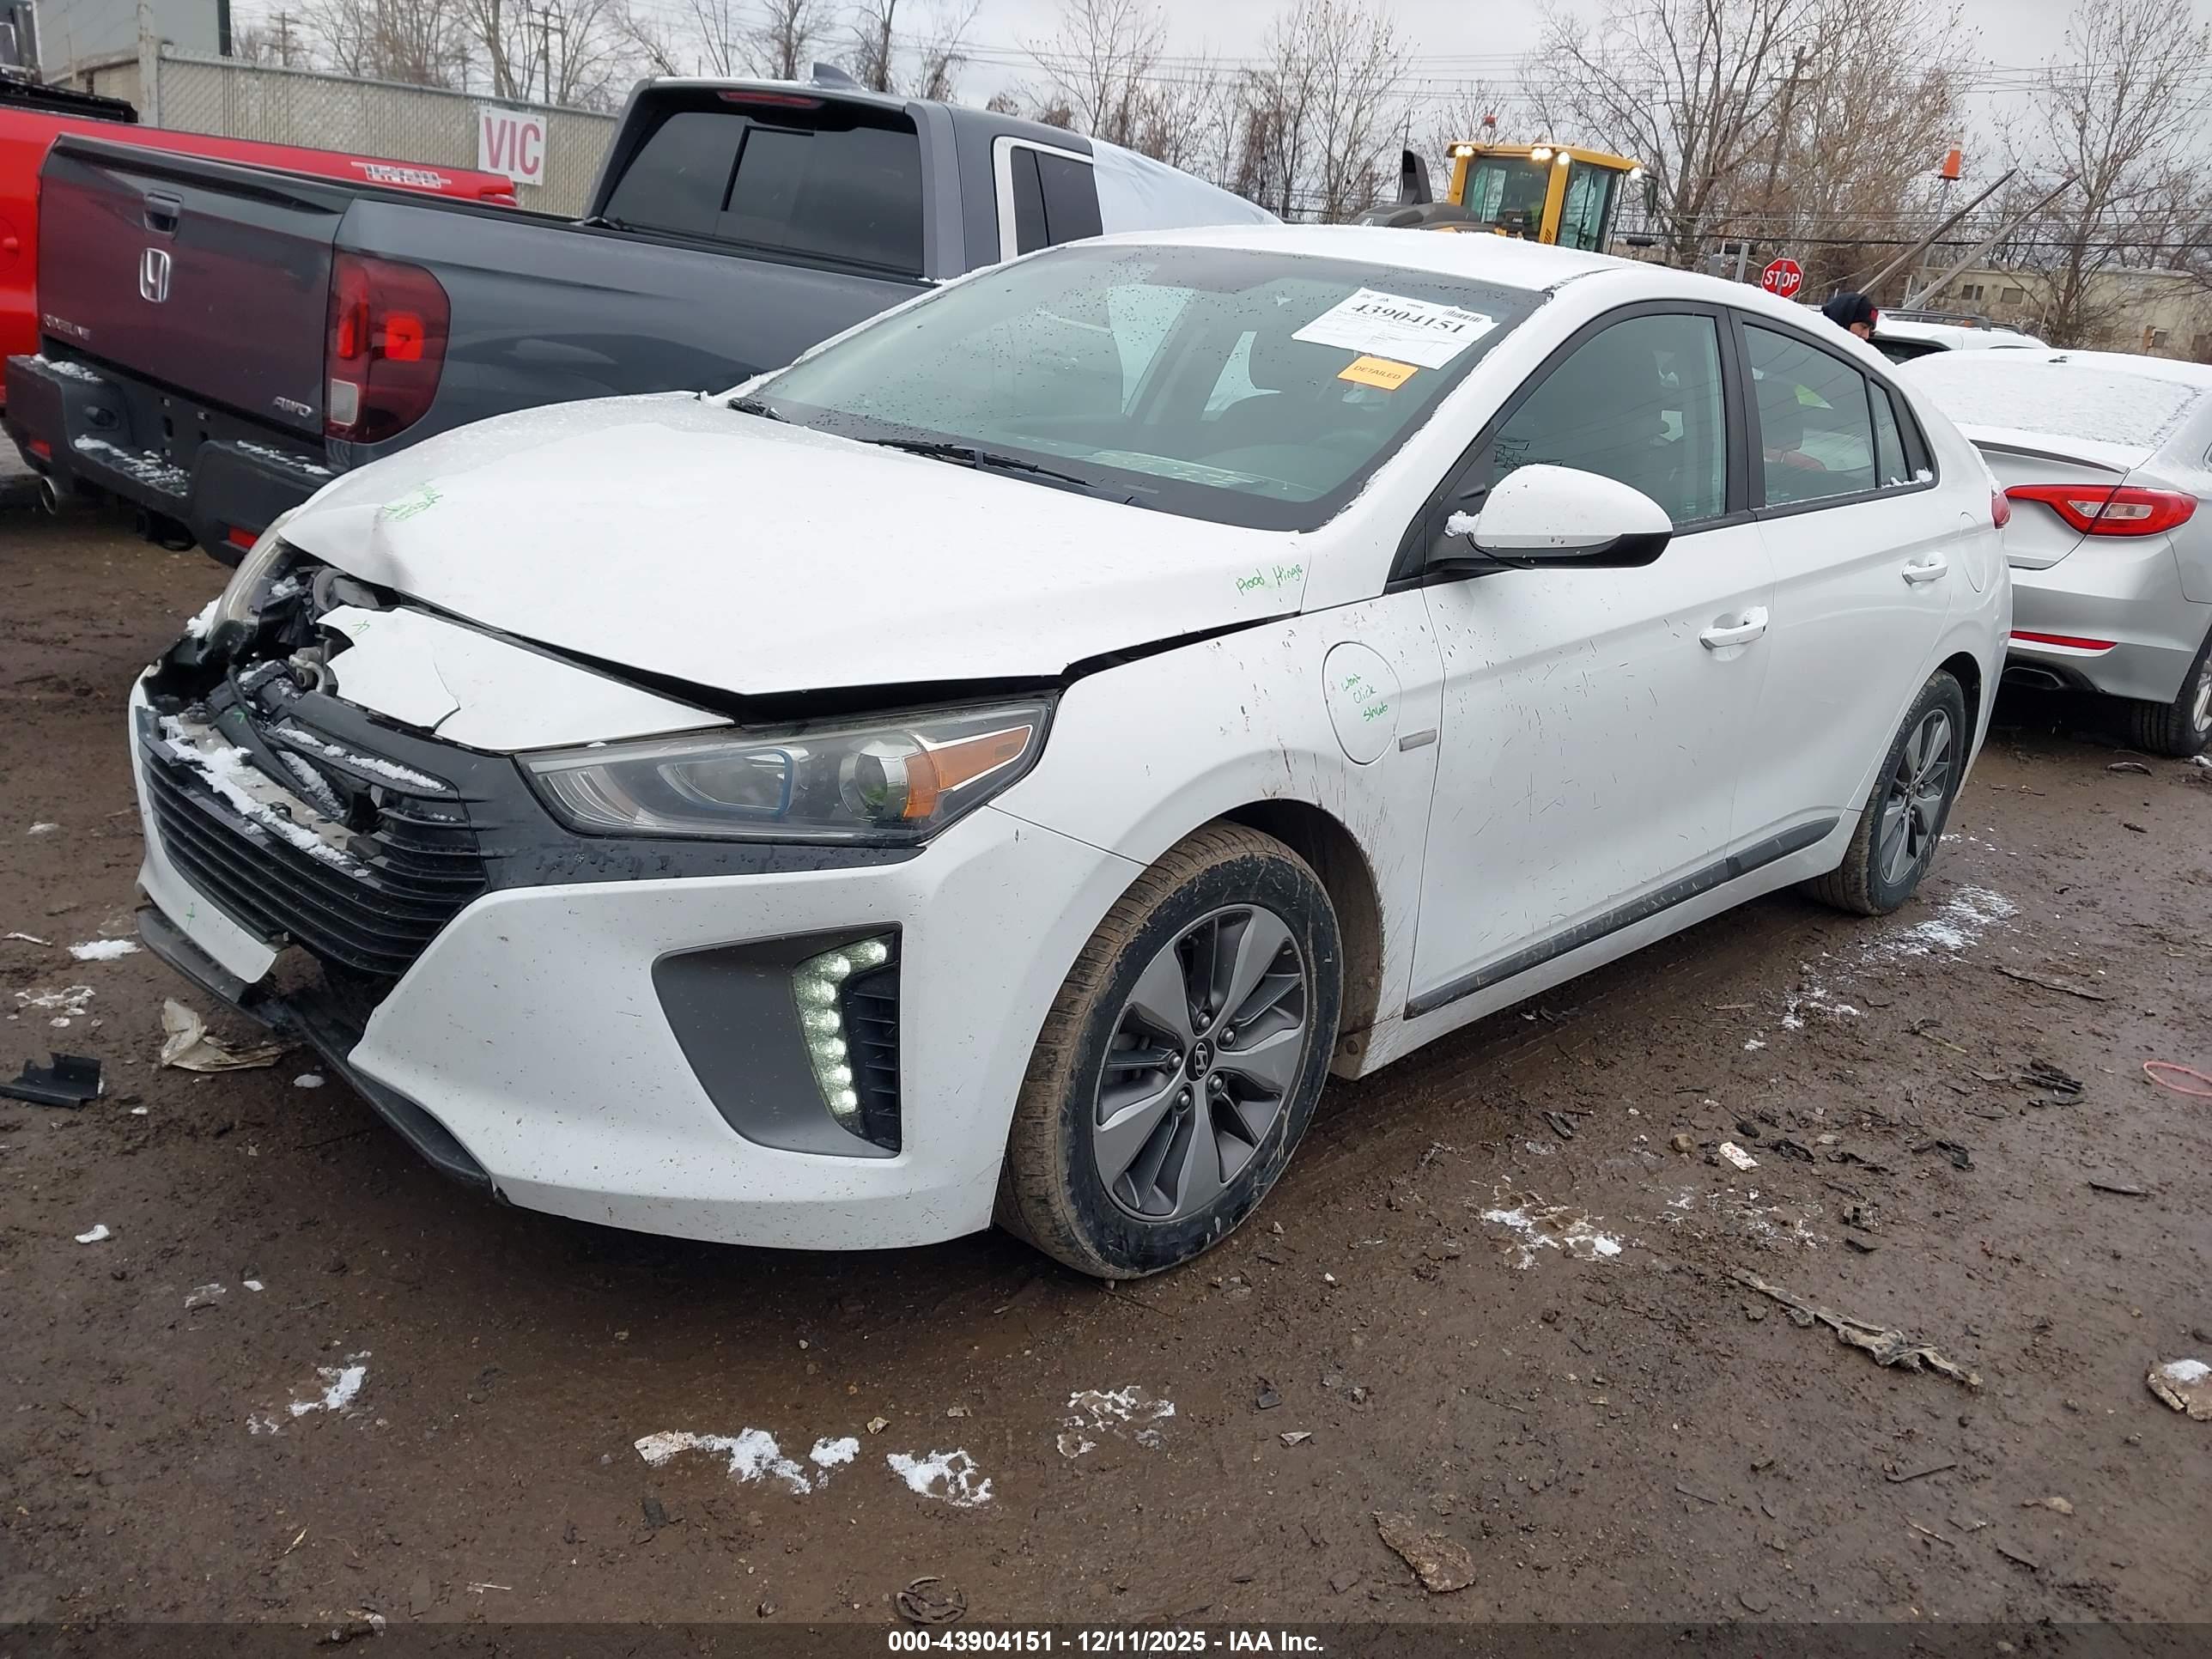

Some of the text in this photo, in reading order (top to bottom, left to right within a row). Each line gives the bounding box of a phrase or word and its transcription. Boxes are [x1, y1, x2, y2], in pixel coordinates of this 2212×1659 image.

[484, 116, 541, 175] VIC
[1765, 270, 1800, 289] STOP
[1351, 303, 1466, 333] 43904151
[1354, 365, 1401, 380] DETAILED
[1273, 563, 1304, 587] Hinge
